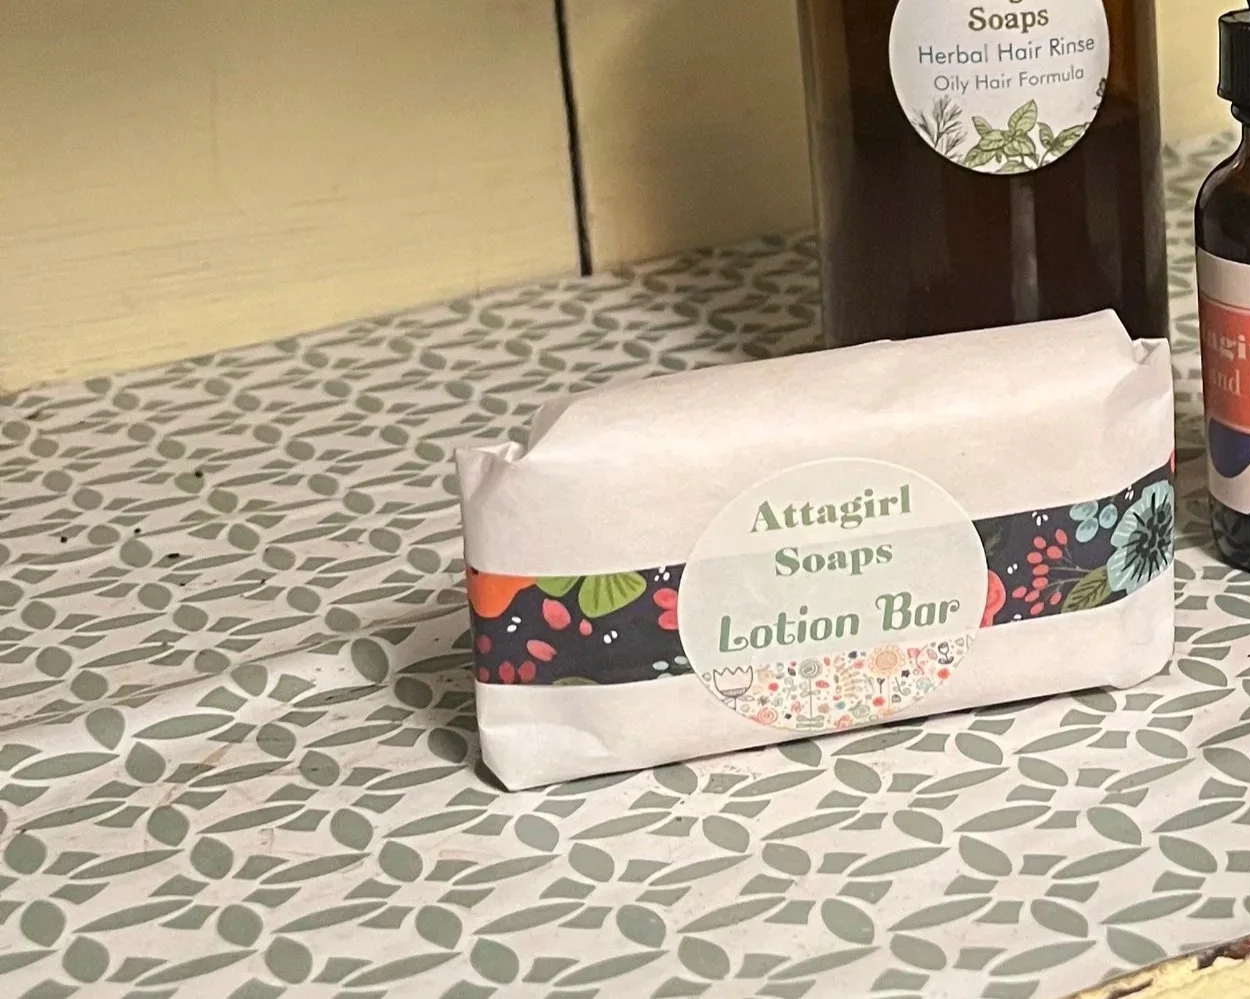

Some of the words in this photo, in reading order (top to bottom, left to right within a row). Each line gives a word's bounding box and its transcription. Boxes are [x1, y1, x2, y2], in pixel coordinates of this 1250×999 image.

[968, 7, 1049, 33] Soaps
[918, 44, 989, 65] Herbal
[998, 41, 1042, 61] Hair
[1050, 37, 1095, 57] Rinse
[934, 74, 969, 94] Oily
[975, 75, 1012, 91] Hair
[1019, 64, 1085, 87] Formula
[750, 483, 912, 533] Attagirl
[774, 543, 893, 577] Soaps
[719, 605, 860, 653] Lotion
[875, 591, 960, 632] Bar
